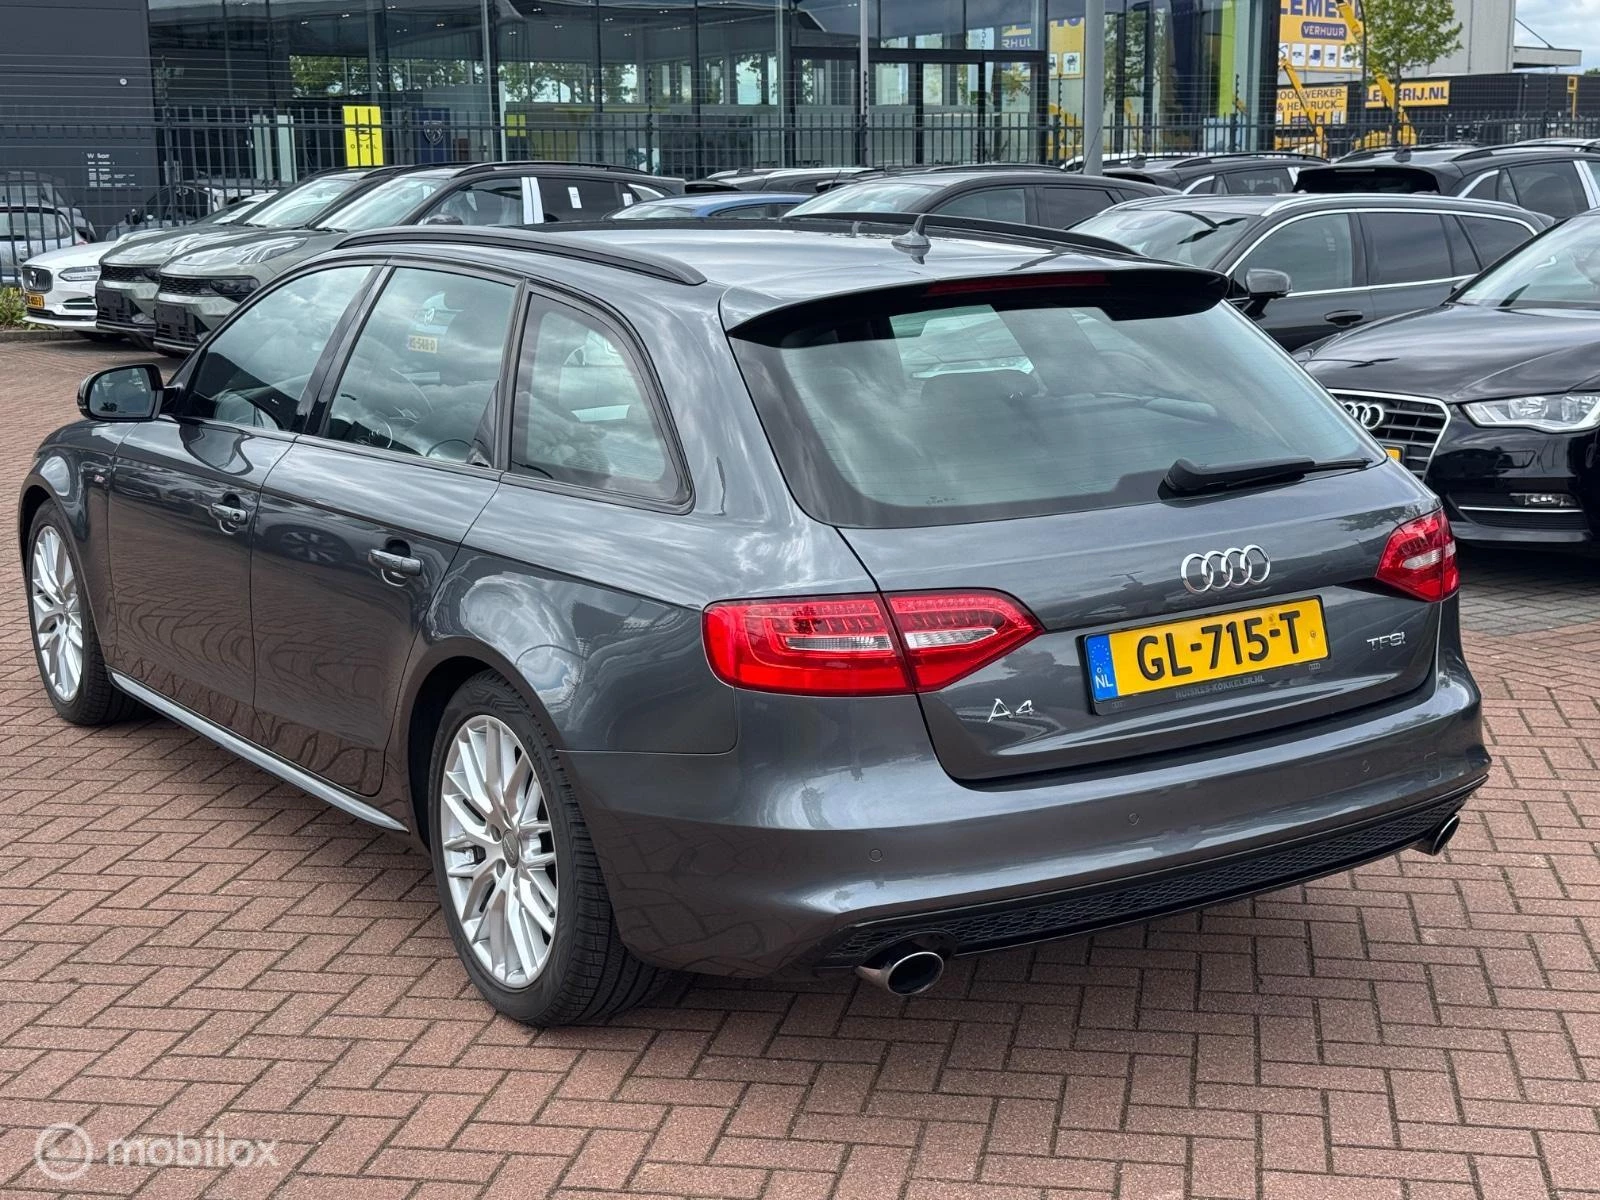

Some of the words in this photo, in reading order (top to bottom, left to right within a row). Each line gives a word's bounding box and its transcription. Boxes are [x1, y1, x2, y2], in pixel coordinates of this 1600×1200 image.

[1303, 25, 1345, 37] VERHUUR
[1136, 610, 1301, 682] GL-715-T
[1366, 631, 1406, 651] TFSI
[1096, 673, 1114, 689] NL
[987, 698, 1034, 723] A4
